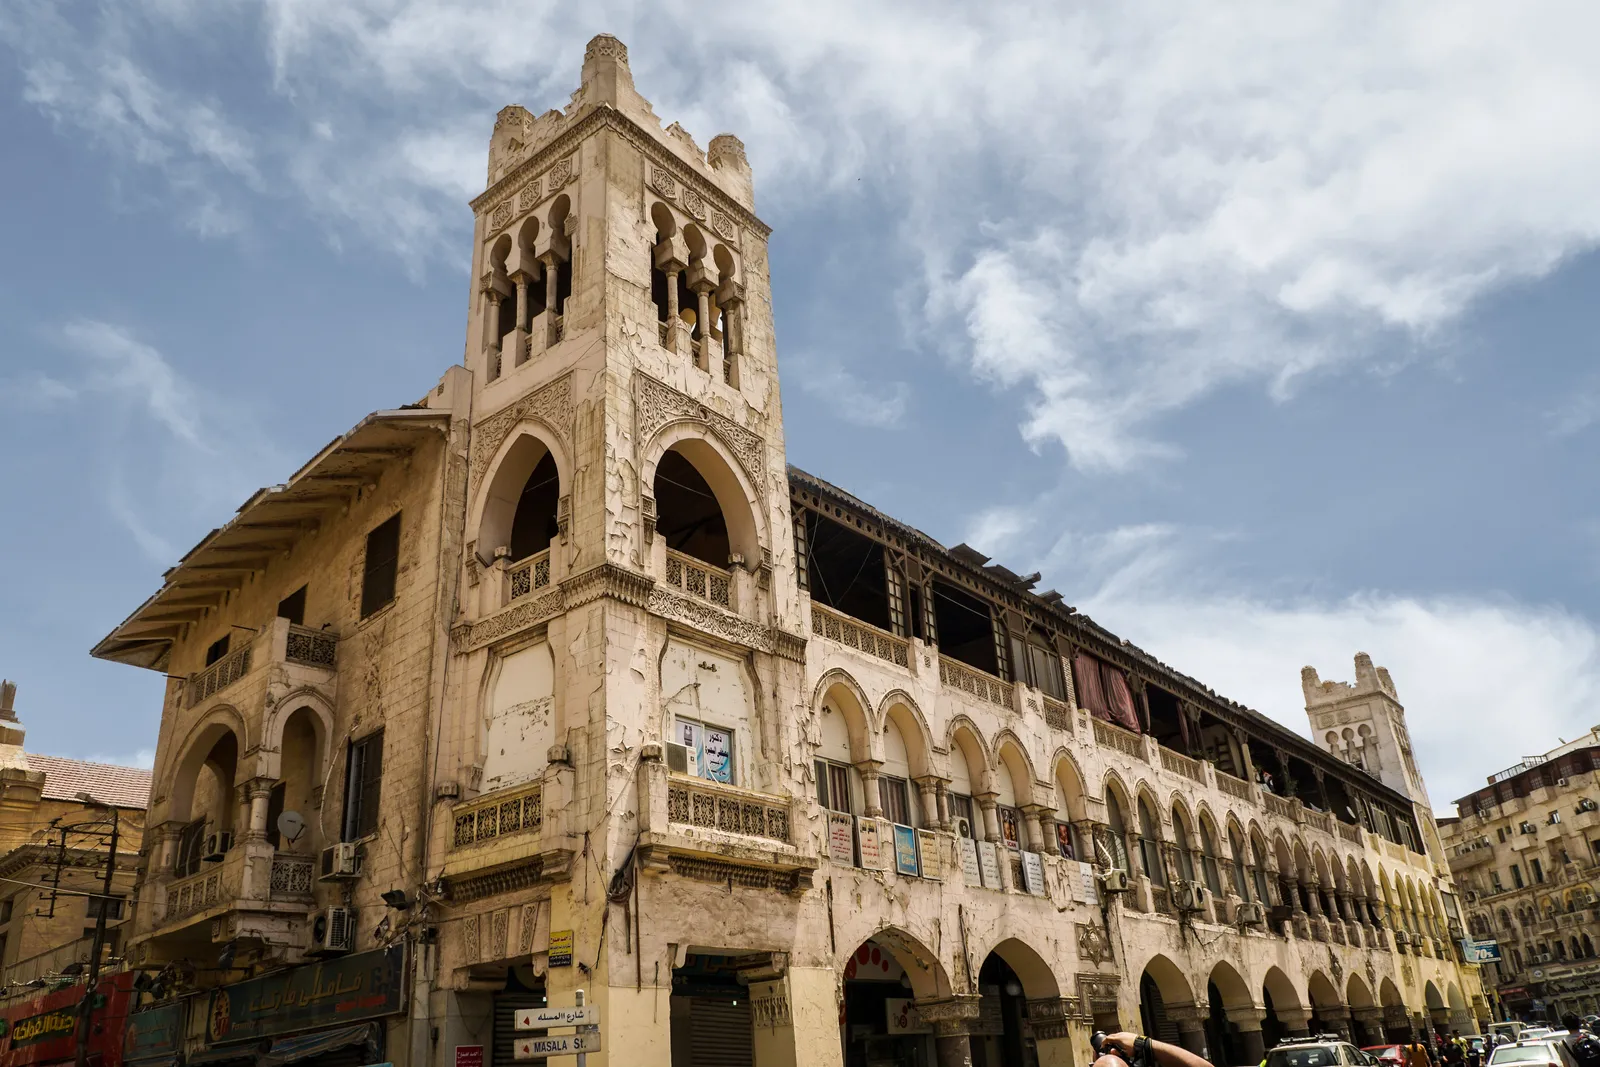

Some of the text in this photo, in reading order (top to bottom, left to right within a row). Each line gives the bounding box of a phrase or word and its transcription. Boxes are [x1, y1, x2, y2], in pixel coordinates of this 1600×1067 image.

[566, 1010, 585, 1023] شارع
[534, 1038, 587, 1053] MASALA St.
